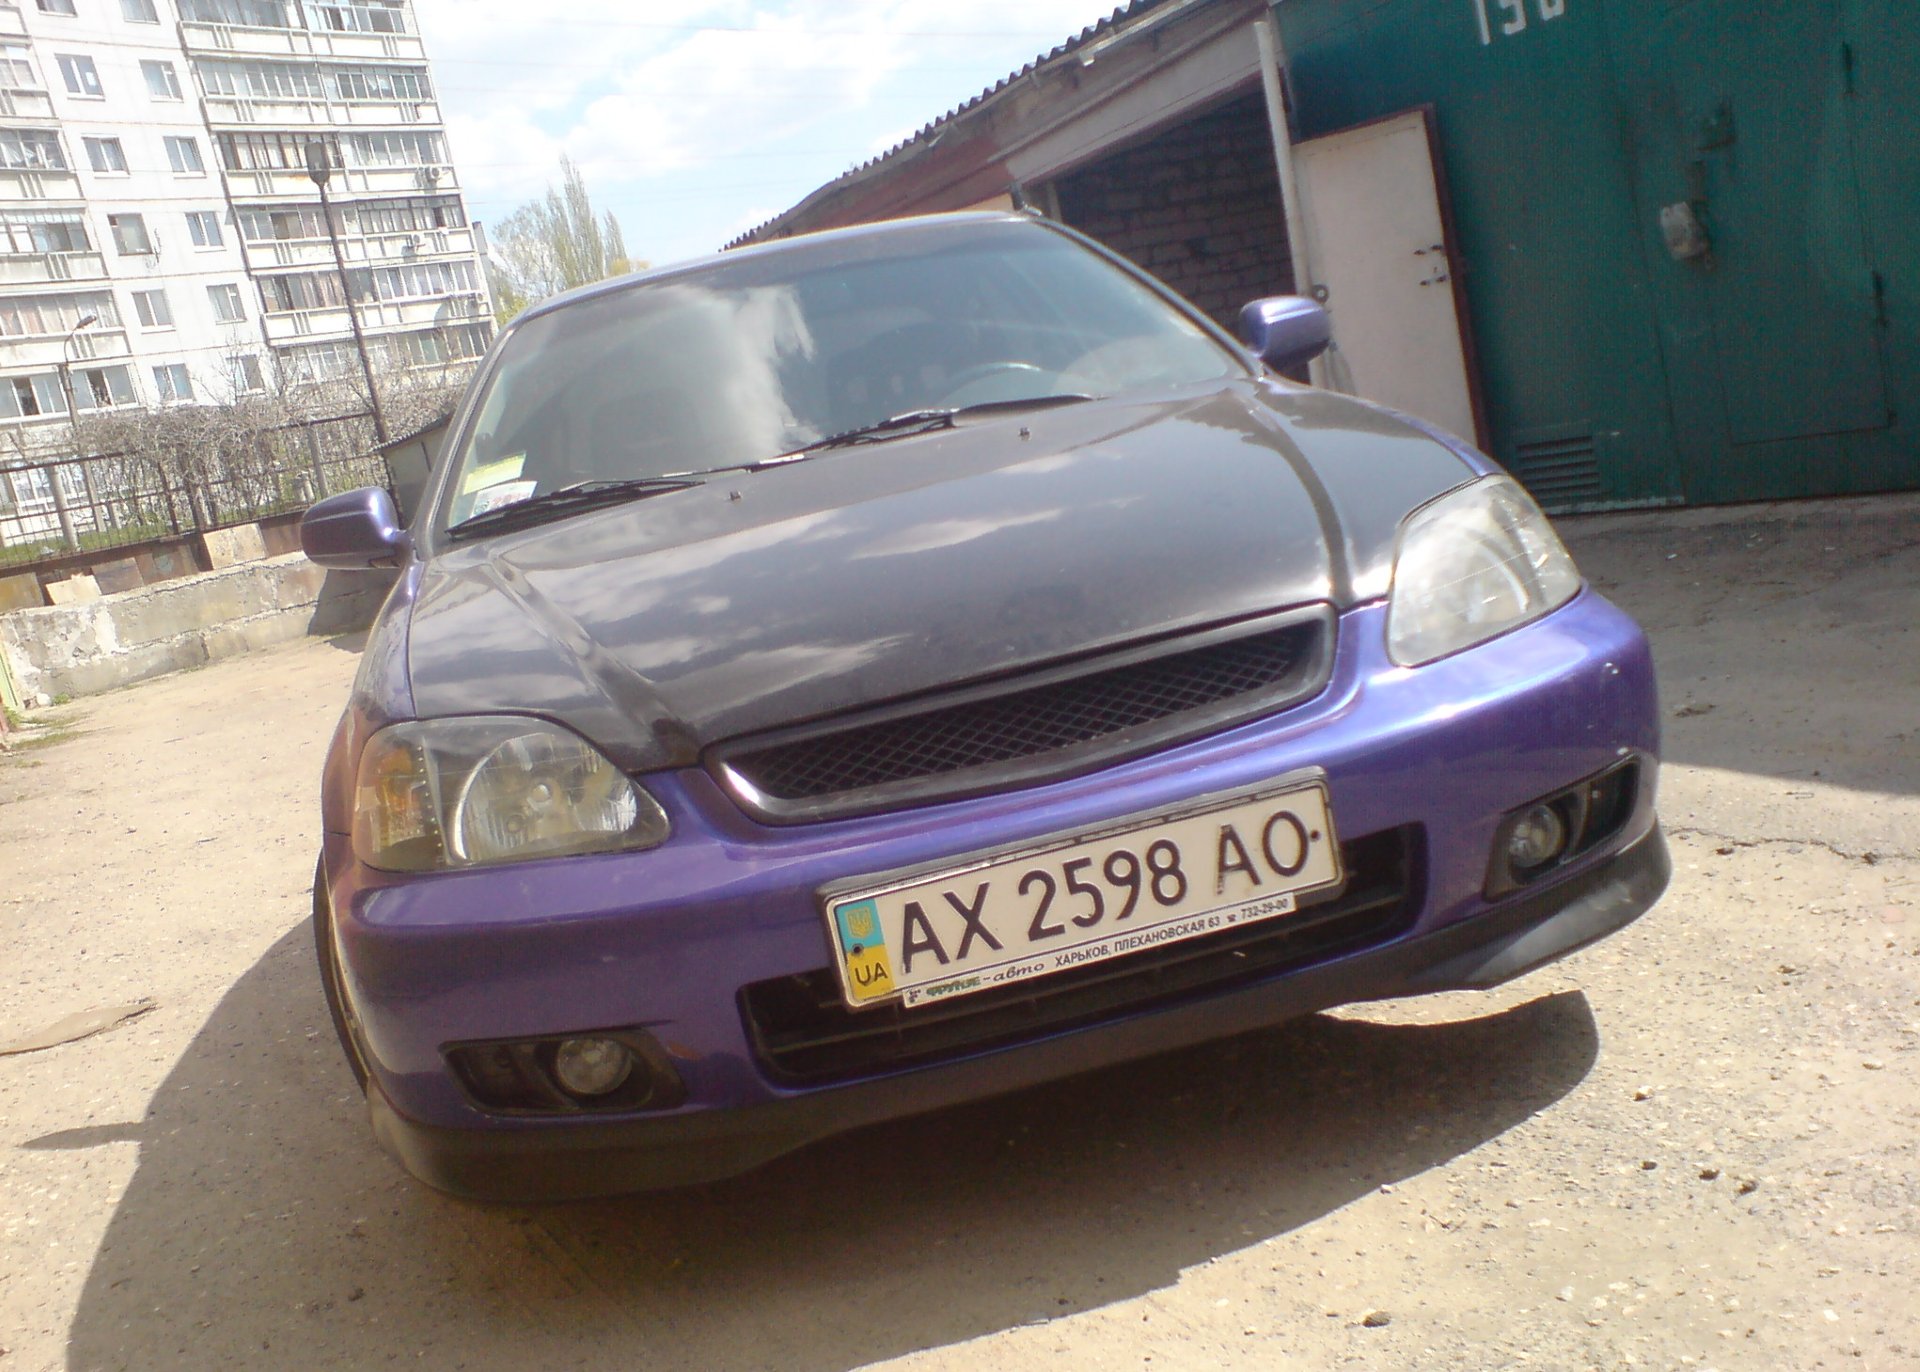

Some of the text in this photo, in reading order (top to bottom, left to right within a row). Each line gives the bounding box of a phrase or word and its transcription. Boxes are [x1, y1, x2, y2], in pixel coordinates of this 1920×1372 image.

[902, 810, 1310, 974] AX 2598 AO
[1055, 945, 1111, 968] ХАРЬКОВ,
[1114, 918, 1206, 953] ПЛЕХАНОВСКАЯ
[1208, 915, 1220, 929] 63
[854, 961, 889, 987] UA
